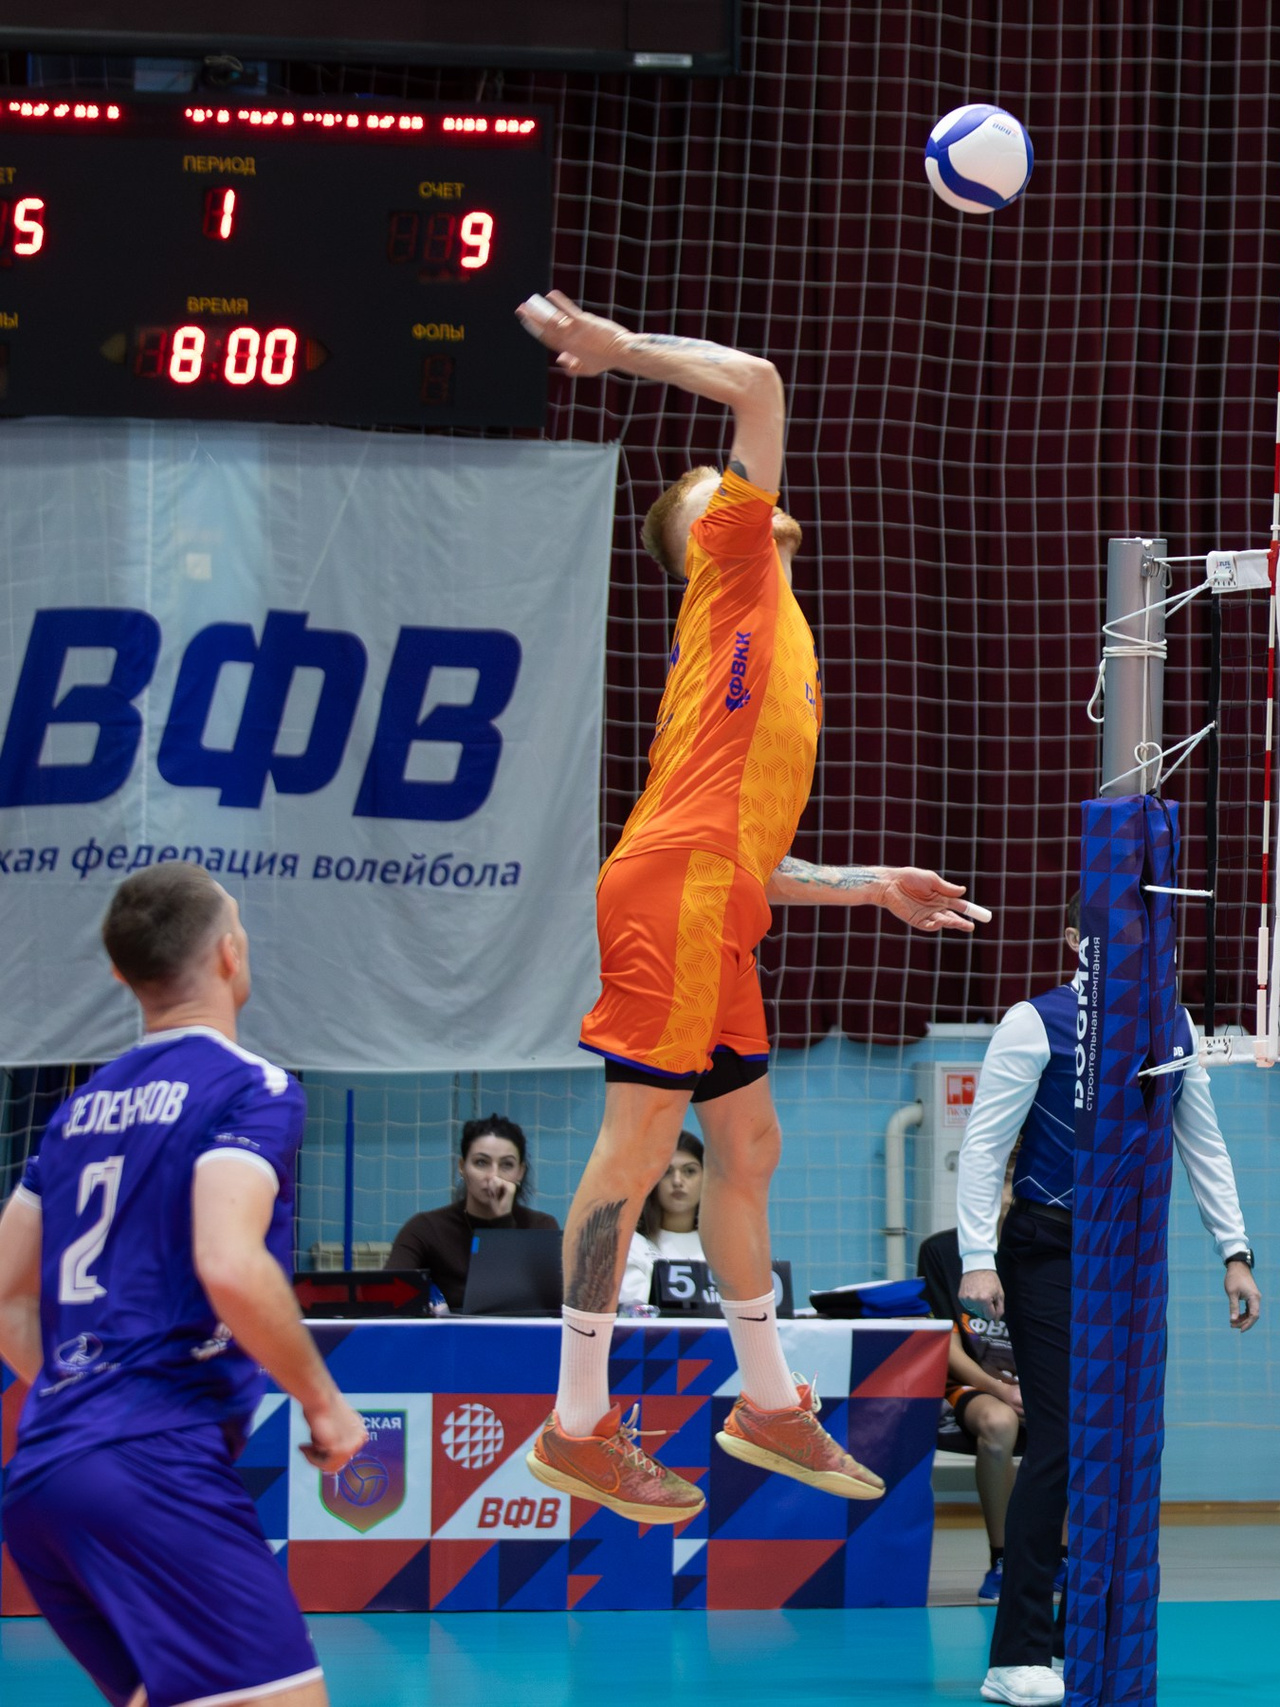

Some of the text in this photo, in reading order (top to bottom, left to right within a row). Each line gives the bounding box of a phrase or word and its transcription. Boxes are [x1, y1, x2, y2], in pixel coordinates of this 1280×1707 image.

[183, 154, 256, 176] ПЕРИОД
[418, 181, 465, 199] СЧЕТ
[14, 197, 44, 254] 5
[220, 189, 236, 239] 1
[461, 211, 494, 268] 9
[187, 296, 249, 315] ВРЕМЯ
[411, 322, 465, 341] ФОЛЫ
[0, 606, 523, 823] ВФВ
[0, 844, 59, 875] кая
[311, 851, 522, 889] волейбола
[1086, 936, 1100, 1112] строительная компания
[57, 1154, 126, 1305] 2
[667, 1264, 697, 1299] 5
[477, 1497, 561, 1529] ВФВ
